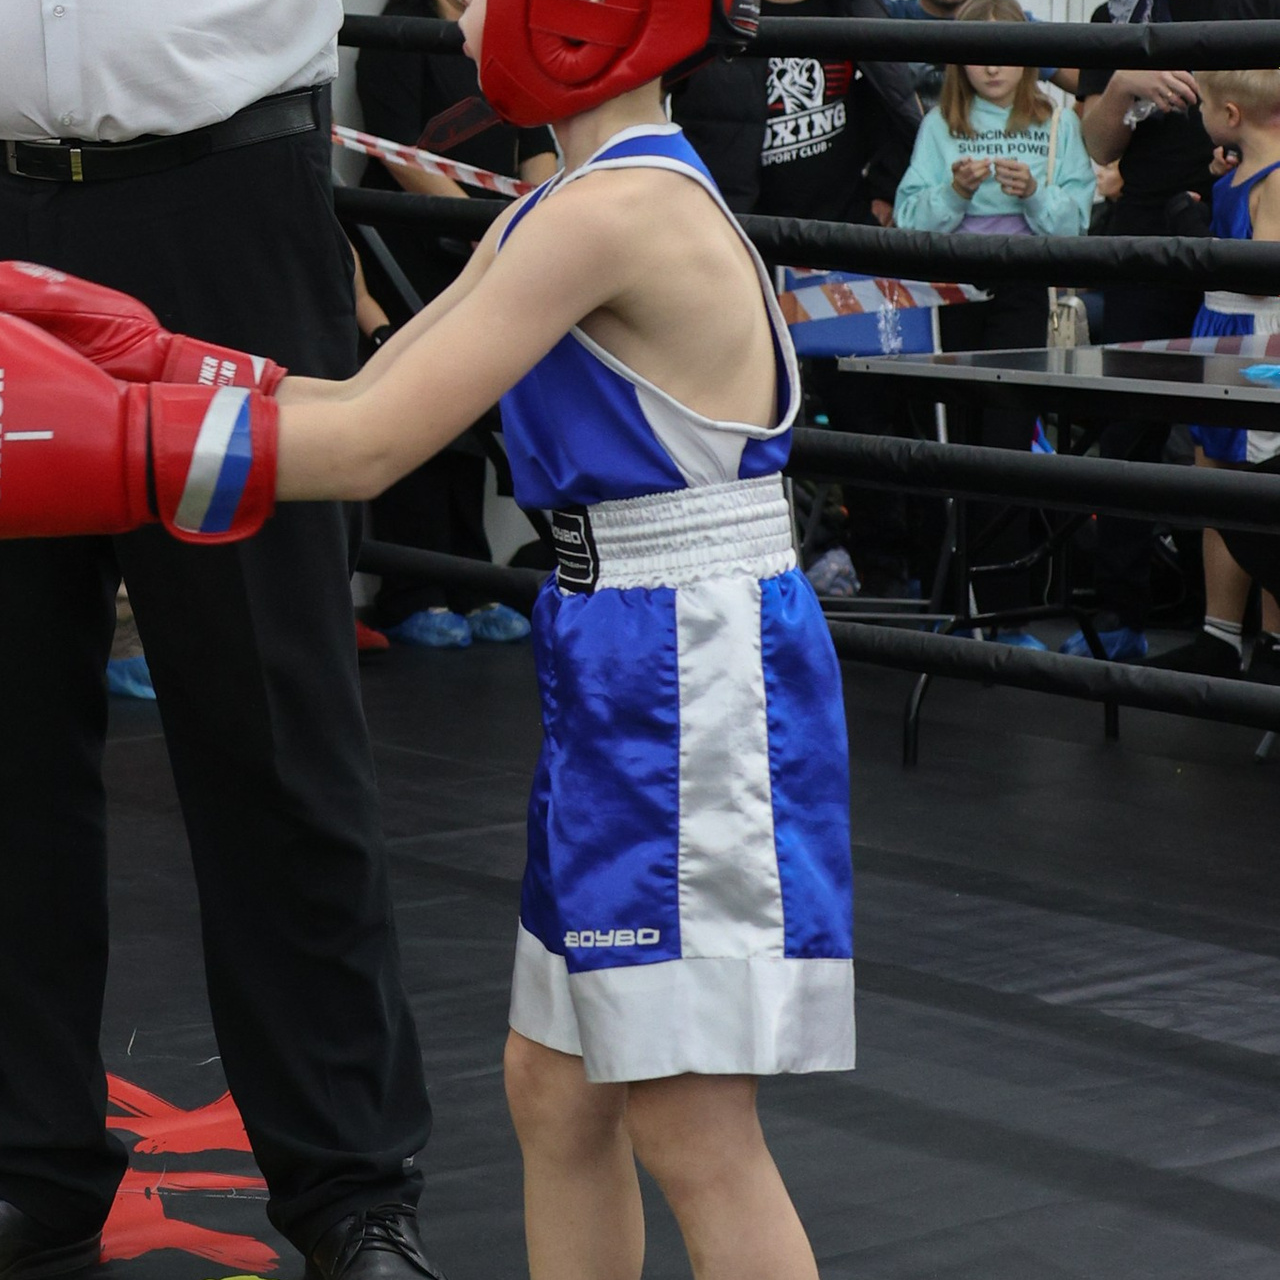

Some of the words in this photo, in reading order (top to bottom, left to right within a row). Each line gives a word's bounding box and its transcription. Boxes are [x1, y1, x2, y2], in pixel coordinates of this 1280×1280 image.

[800, 141, 828, 159] CLUB
[958, 142, 1004, 155] SUPER
[563, 928, 660, 948] BOYBO
